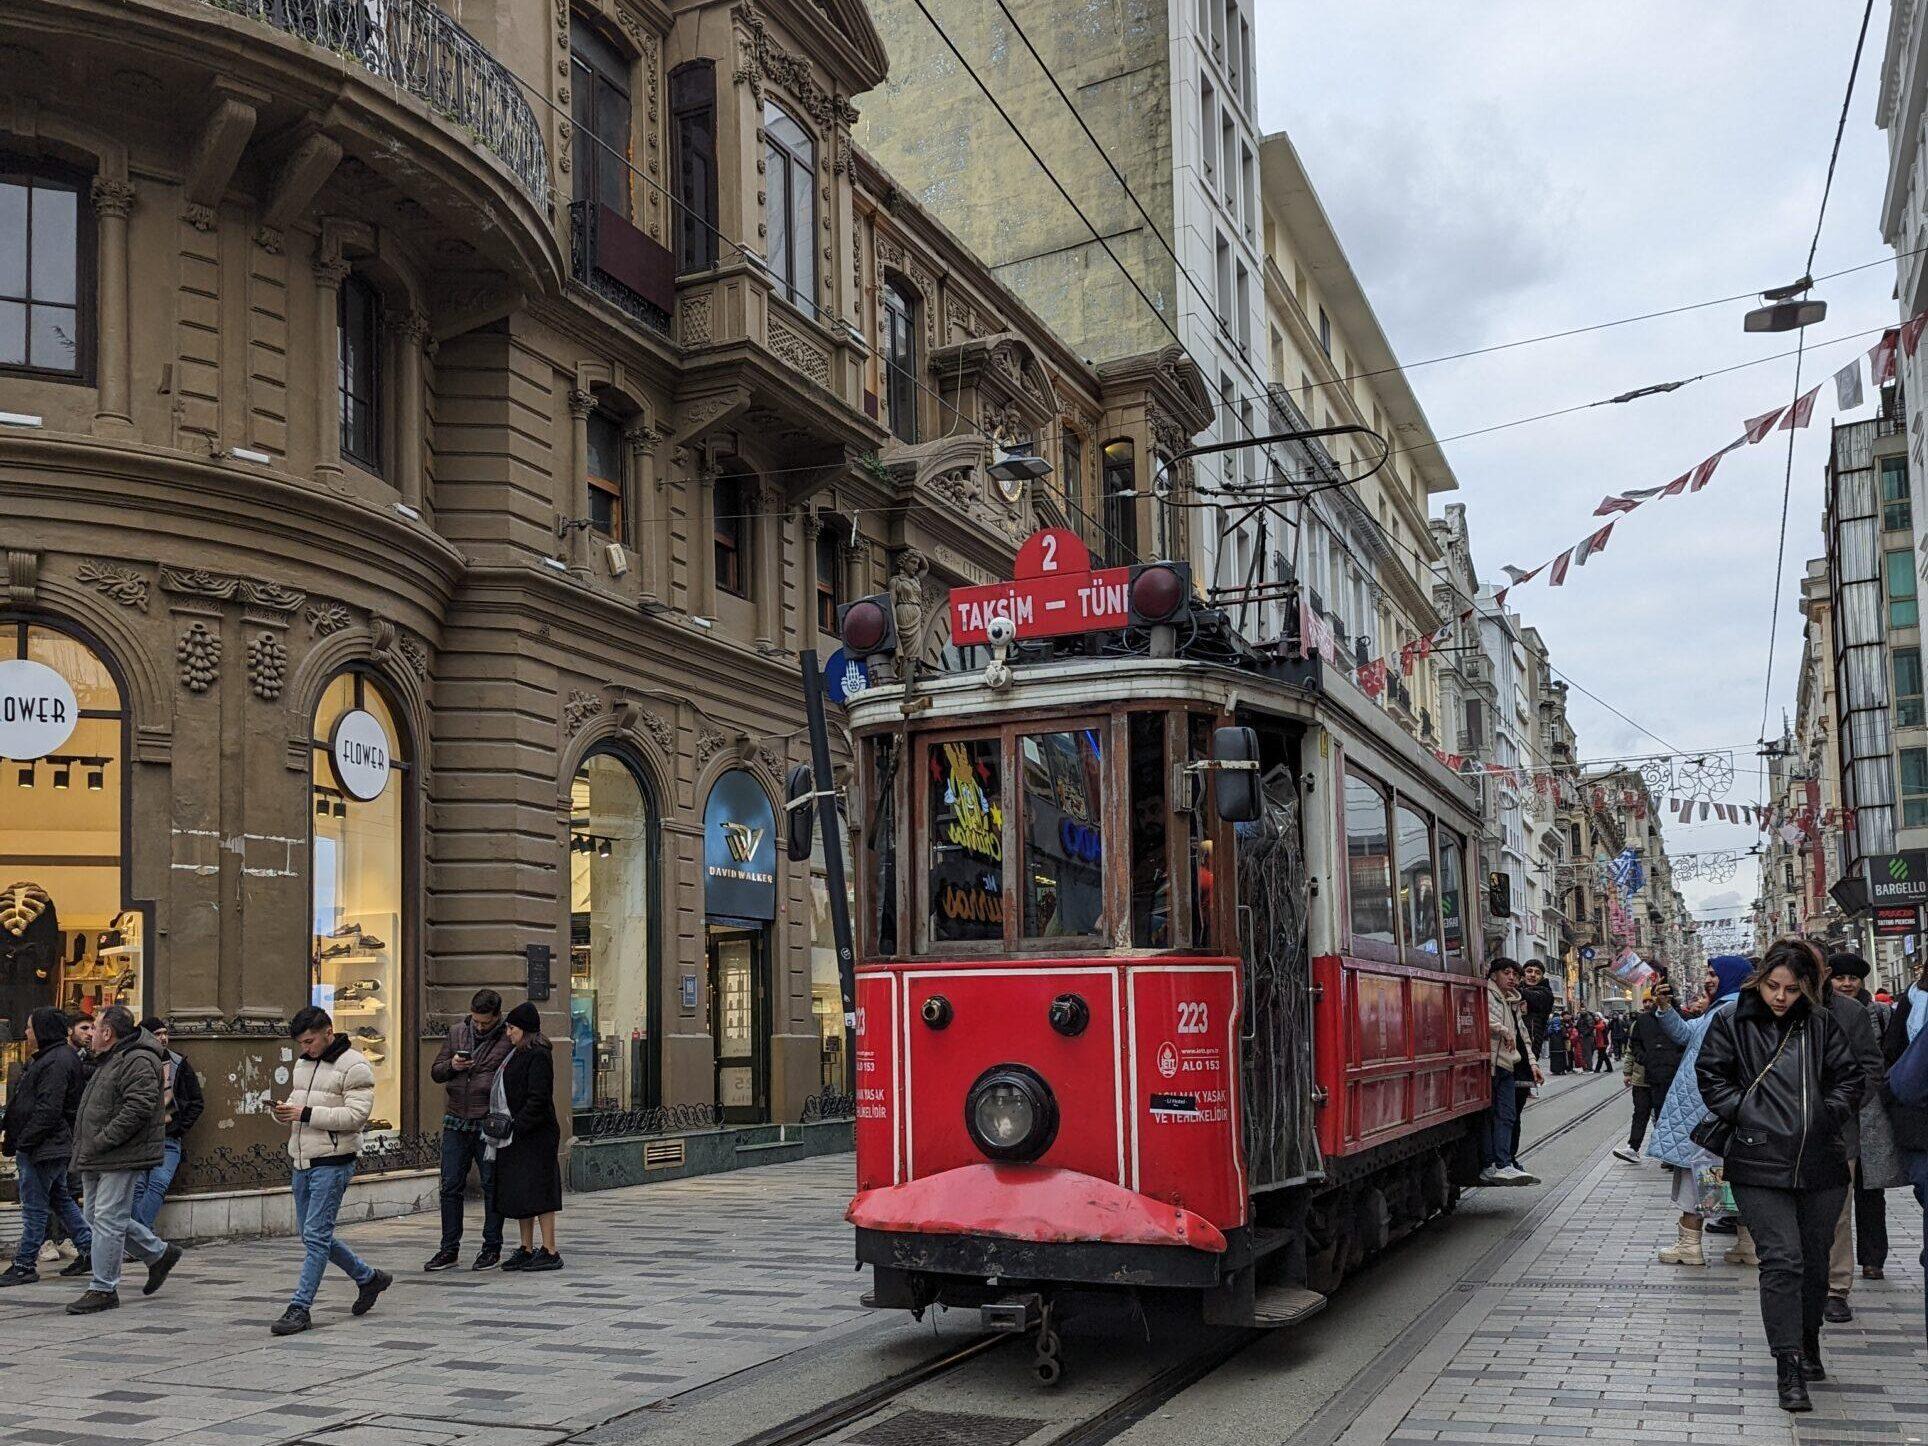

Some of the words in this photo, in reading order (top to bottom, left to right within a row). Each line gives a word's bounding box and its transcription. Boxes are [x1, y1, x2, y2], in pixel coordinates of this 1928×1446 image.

[1041, 534, 1058, 572] 2
[958, 590, 1034, 632] TAKSİM
[1078, 579, 1129, 618] TÜN
[0, 696, 66, 724] OWER
[342, 739, 385, 772] FLOWER
[709, 866, 737, 879] DAVID
[738, 870, 773, 884] WALKER
[1875, 881, 1927, 896] BARGELLO
[1177, 1001, 1208, 1034] 223
[1181, 1060, 1203, 1072] ALO
[1205, 1060, 1220, 1071] 153
[1201, 1090, 1227, 1104] YASAK
[1154, 1111, 1168, 1124] VE
